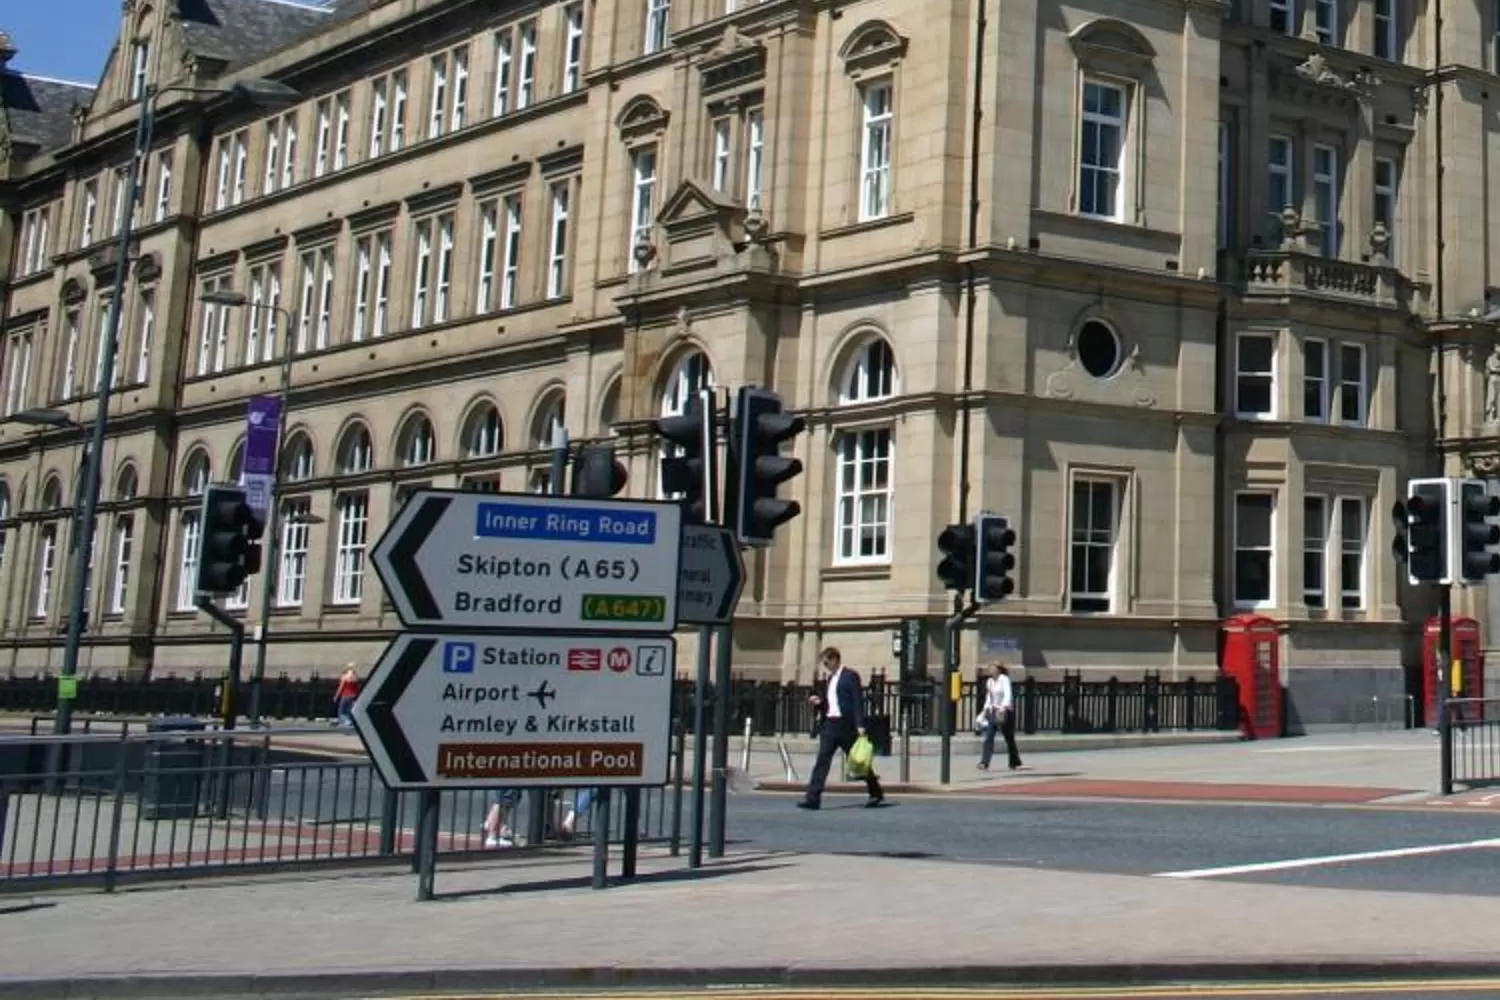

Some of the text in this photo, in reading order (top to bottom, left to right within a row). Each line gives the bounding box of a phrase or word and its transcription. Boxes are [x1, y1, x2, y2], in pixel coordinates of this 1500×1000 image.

[485, 511, 650, 536] Inner Ring Road
[457, 553, 640, 582] Skipton (A65)
[455, 591, 562, 614] Bradford
[585, 597, 663, 618] (A647)
[451, 646, 471, 670] P
[482, 647, 561, 666] Station
[609, 652, 629, 667] M
[442, 683, 520, 702] Airport
[440, 715, 636, 736] Armley & Kirkstall
[446, 751, 636, 770] International Pool
